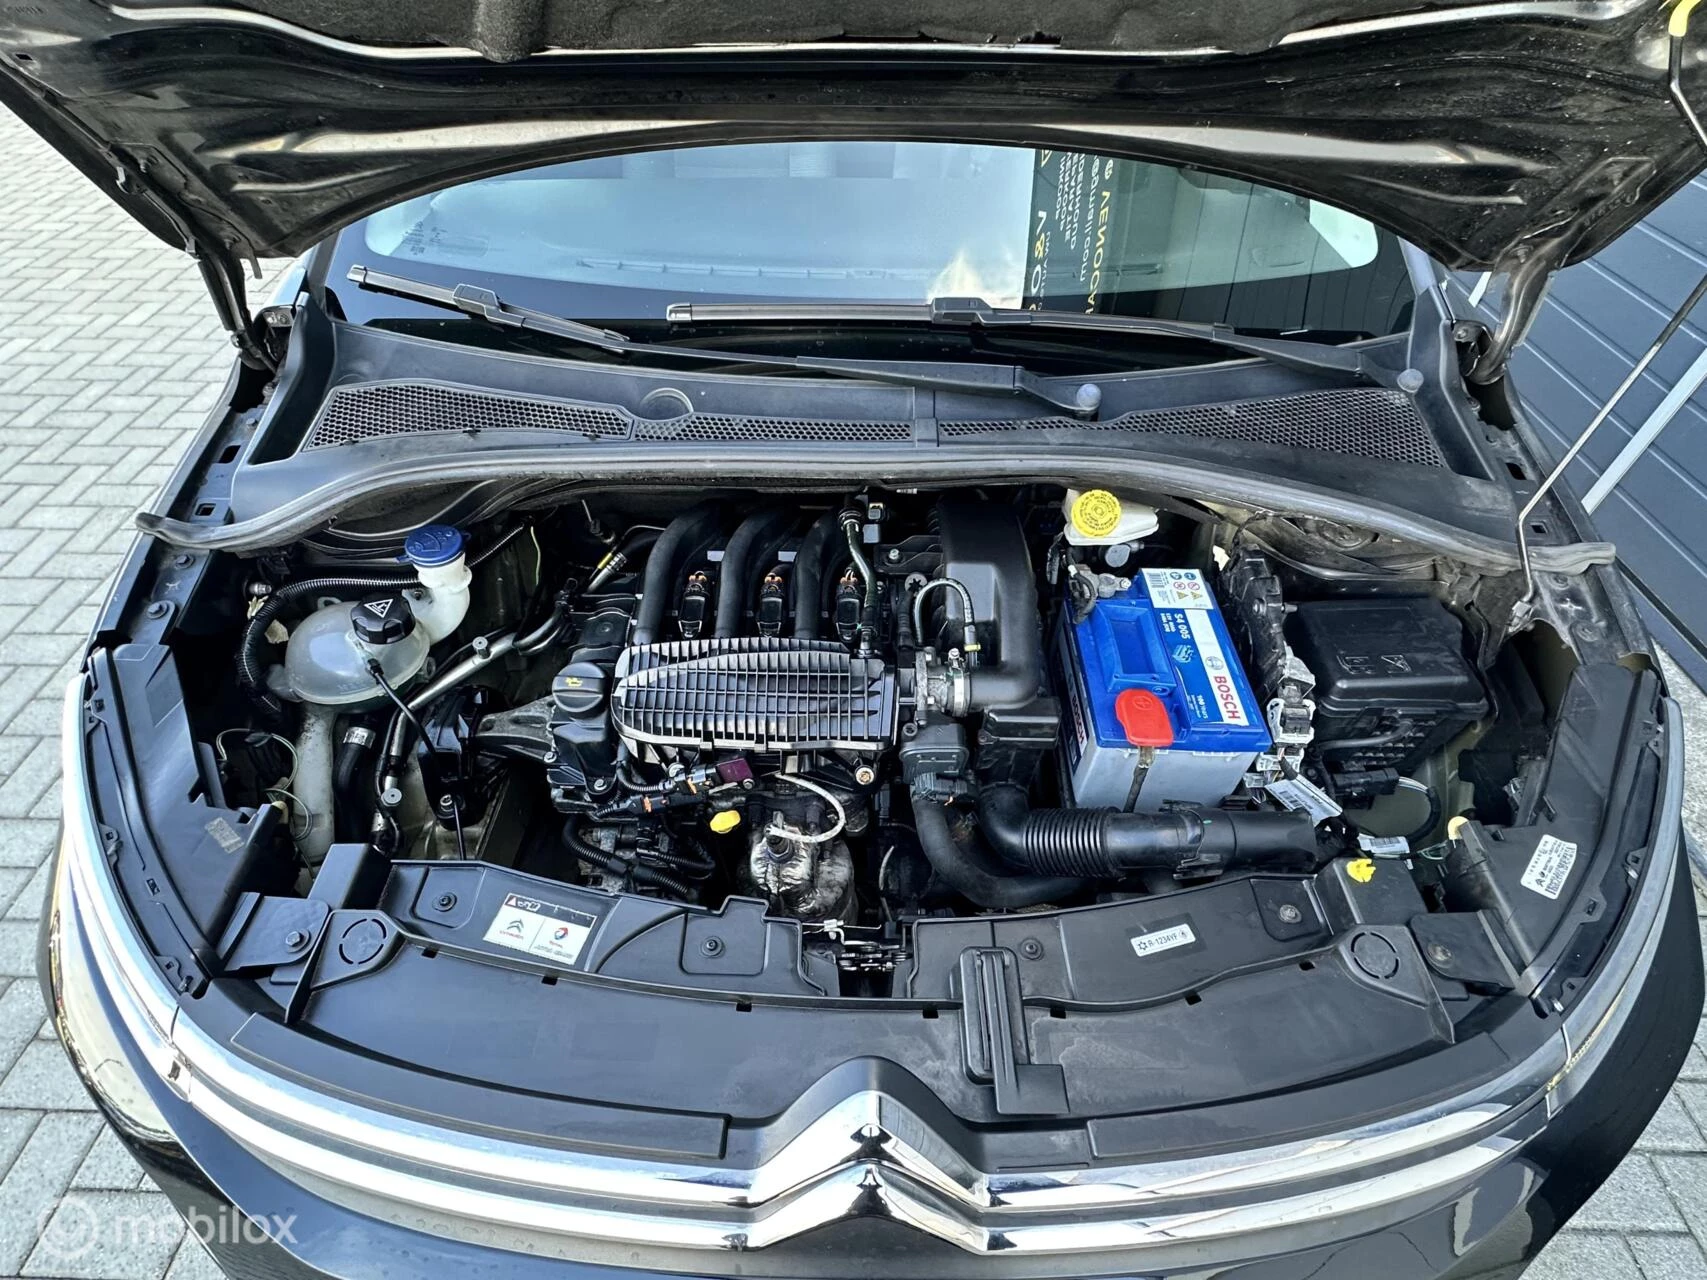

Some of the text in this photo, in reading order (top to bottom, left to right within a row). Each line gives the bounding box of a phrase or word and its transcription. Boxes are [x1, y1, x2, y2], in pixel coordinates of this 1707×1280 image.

[1174, 613, 1191, 640] S4 005
[1071, 696, 1085, 744] BOSCH
[1213, 675, 1241, 720] BOSCH
